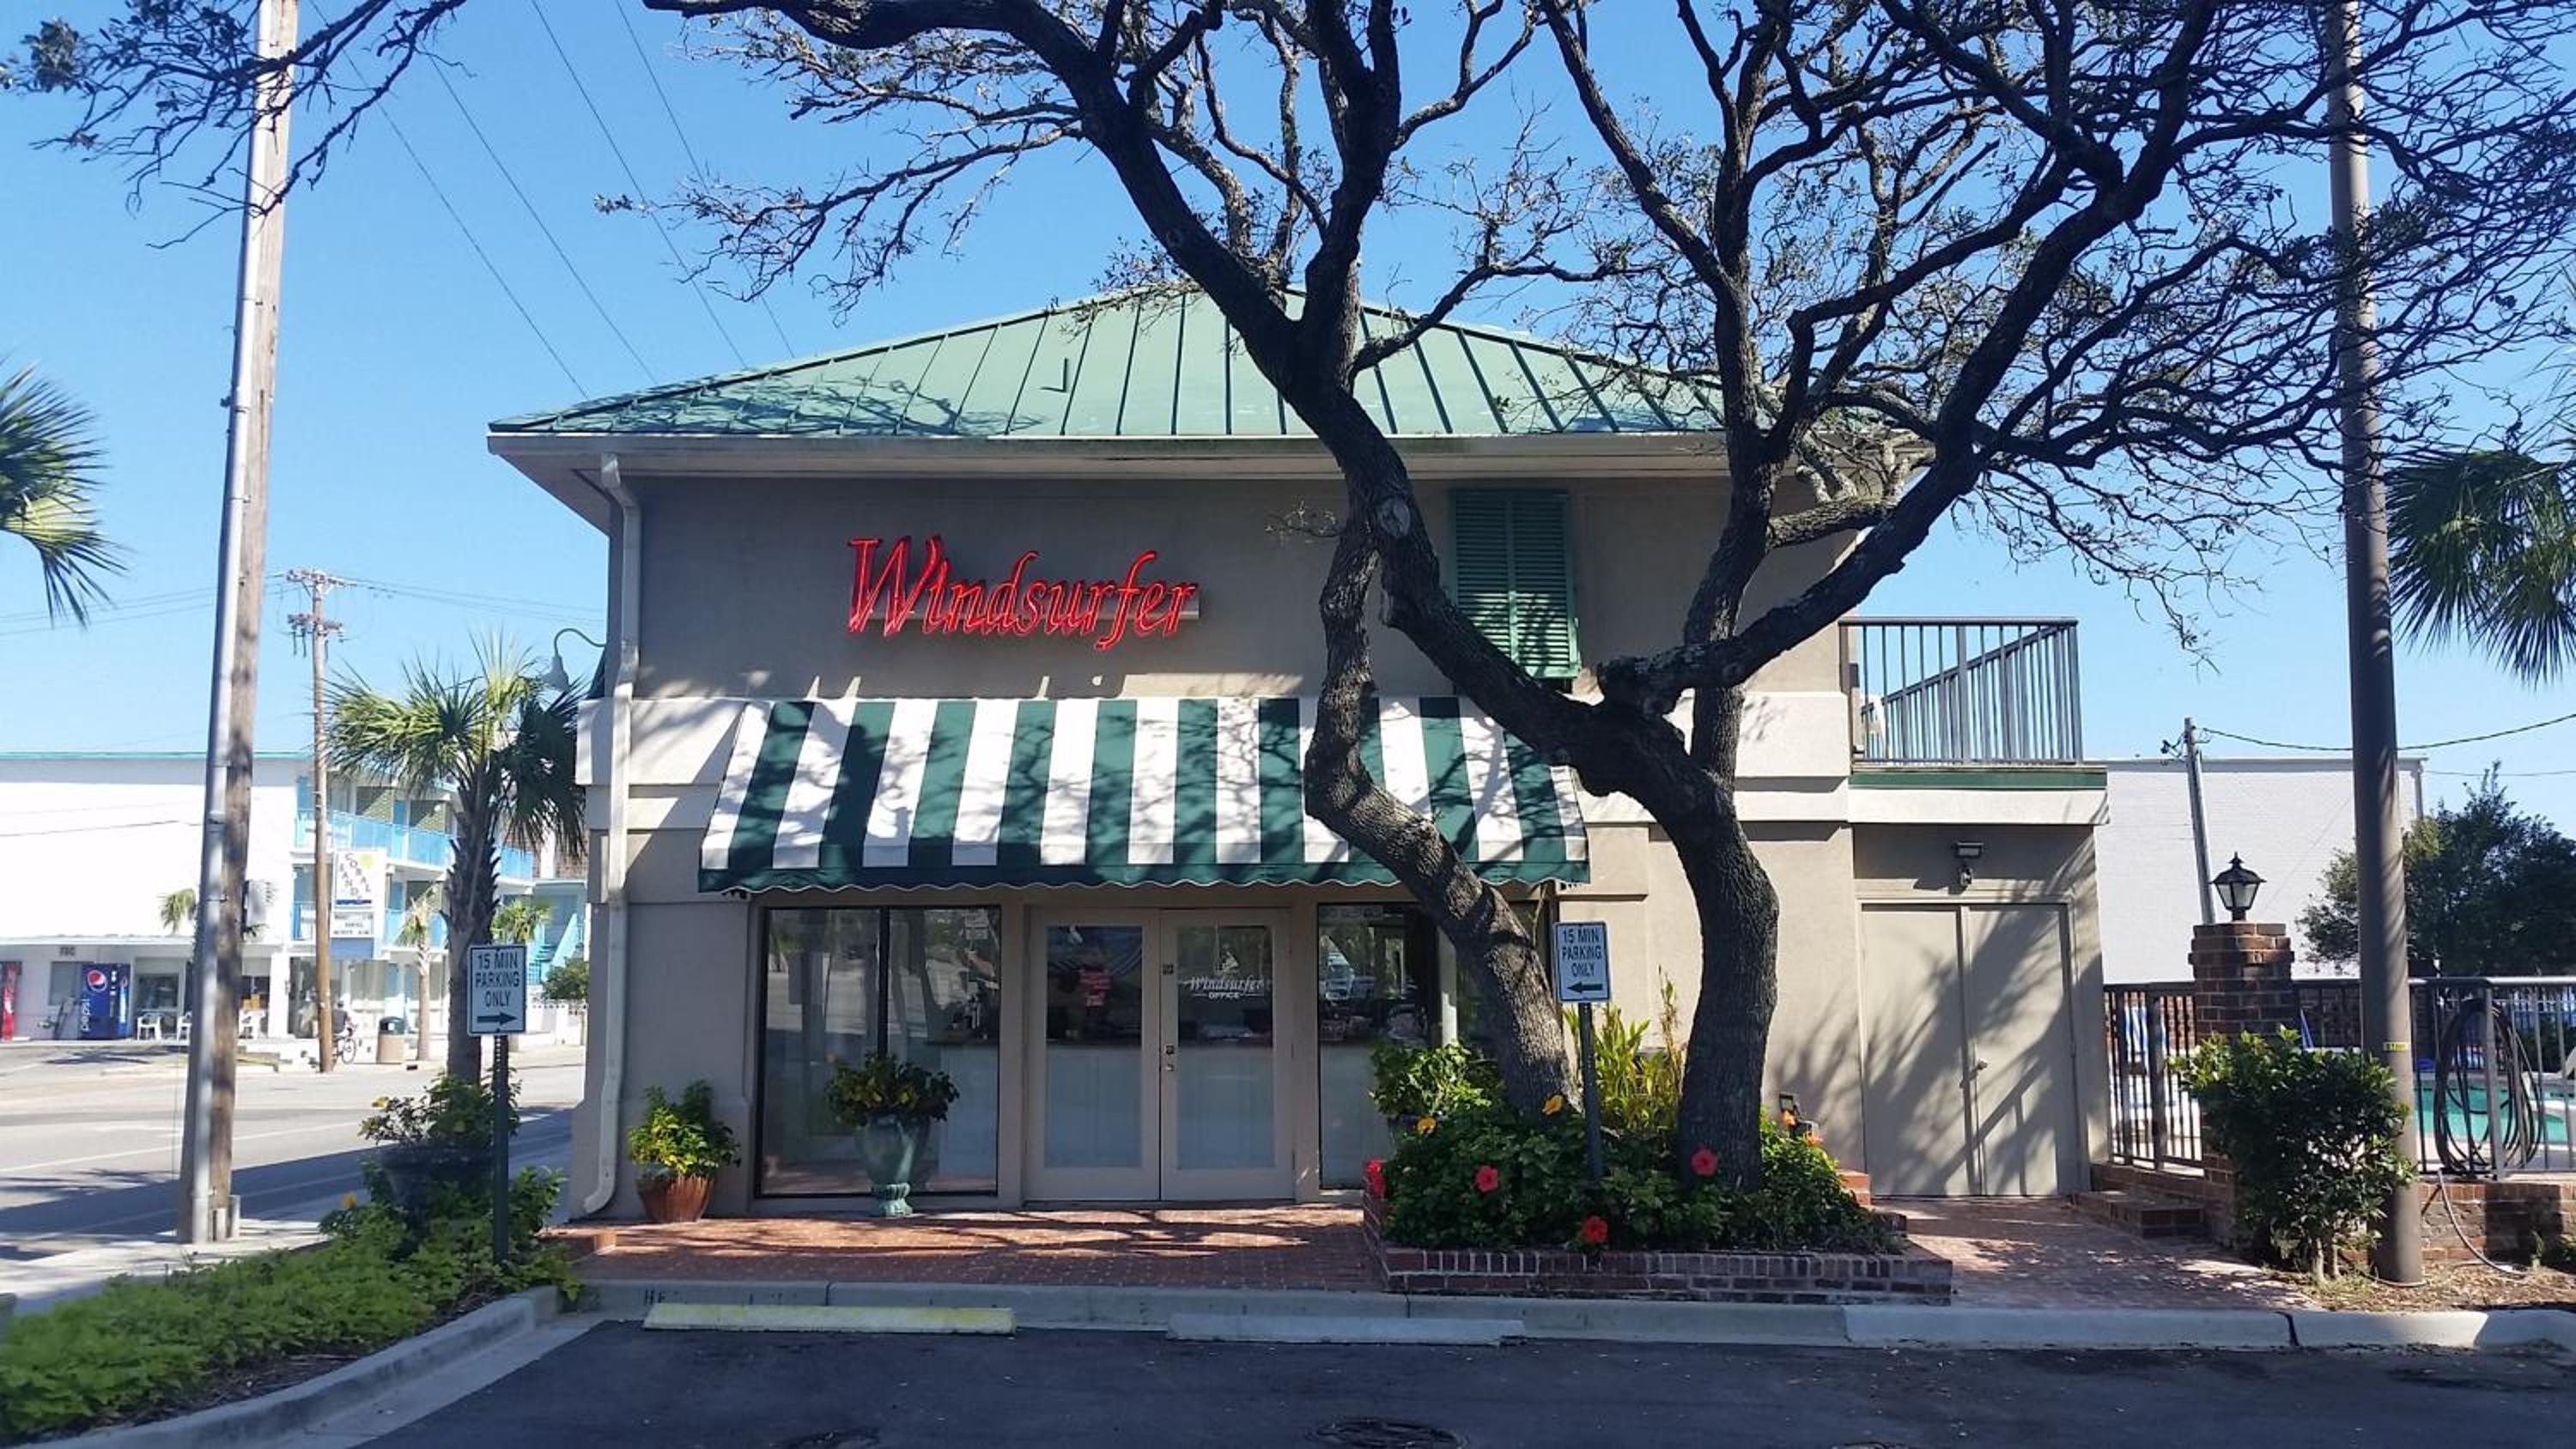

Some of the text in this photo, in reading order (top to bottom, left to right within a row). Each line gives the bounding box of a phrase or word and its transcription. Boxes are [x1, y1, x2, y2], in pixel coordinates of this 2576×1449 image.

[848, 535, 1199, 651] Windsurfer
[1563, 927, 1600, 943] 15 MIN
[477, 951, 519, 969] 15 MIN
[1562, 945, 1602, 961] PARKING
[1571, 961, 1595, 978] ONLY
[475, 971, 520, 989] PARKING
[1182, 974, 1264, 993] Windsurfer
[484, 990, 512, 1007] ONLY
[1208, 991, 1241, 1000] OFFICE
